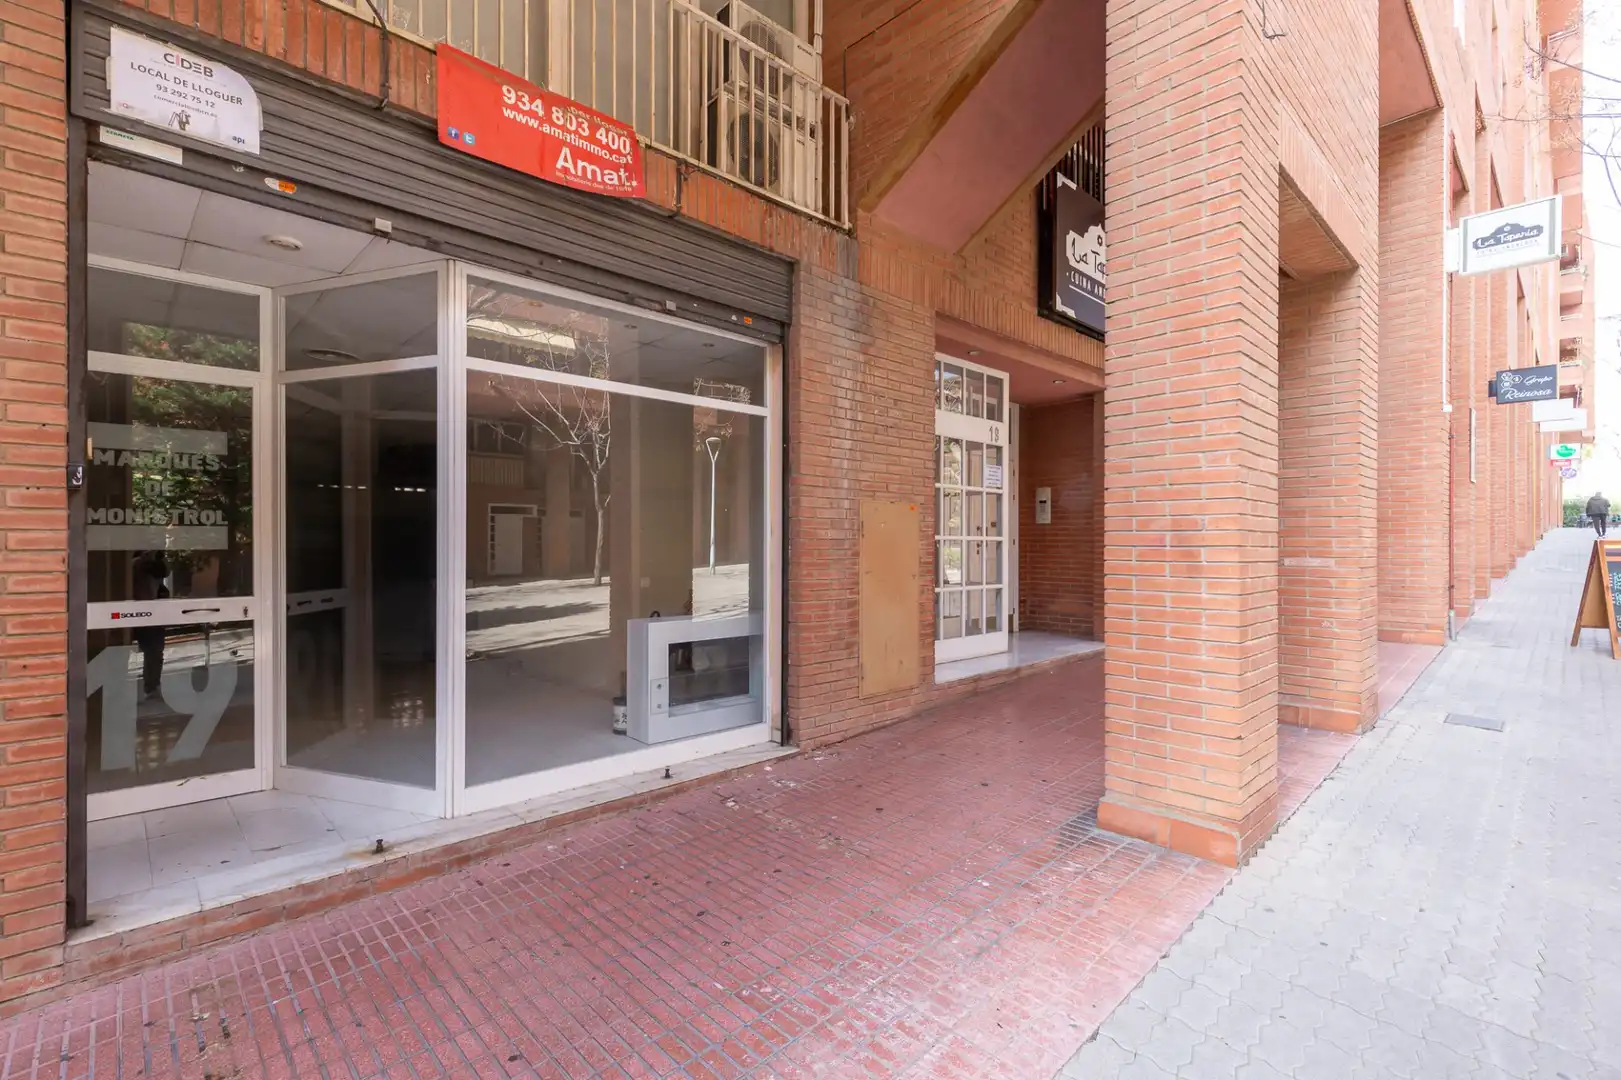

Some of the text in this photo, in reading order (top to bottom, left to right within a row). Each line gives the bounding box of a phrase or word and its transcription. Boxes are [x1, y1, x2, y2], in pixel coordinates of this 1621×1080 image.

[163, 52, 214, 78] CIDEB
[130, 61, 170, 82] LOCAL
[173, 75, 189, 88] DE
[191, 82, 243, 106] LLOGUER
[156, 83, 216, 109] 93 292 75 12
[501, 84, 544, 117] 934
[551, 106, 590, 137] 803
[595, 126, 631, 155] 400
[501, 106, 633, 164] www.amatimmo.cat
[1071, 237, 1089, 265] La
[1476, 238, 1496, 248] La
[1501, 387, 1553, 400] Reinosa
[93, 449, 220, 471] MARQUES
[144, 480, 176, 497] DE
[87, 507, 229, 525] MONISTROL
[87, 645, 237, 771] 19
